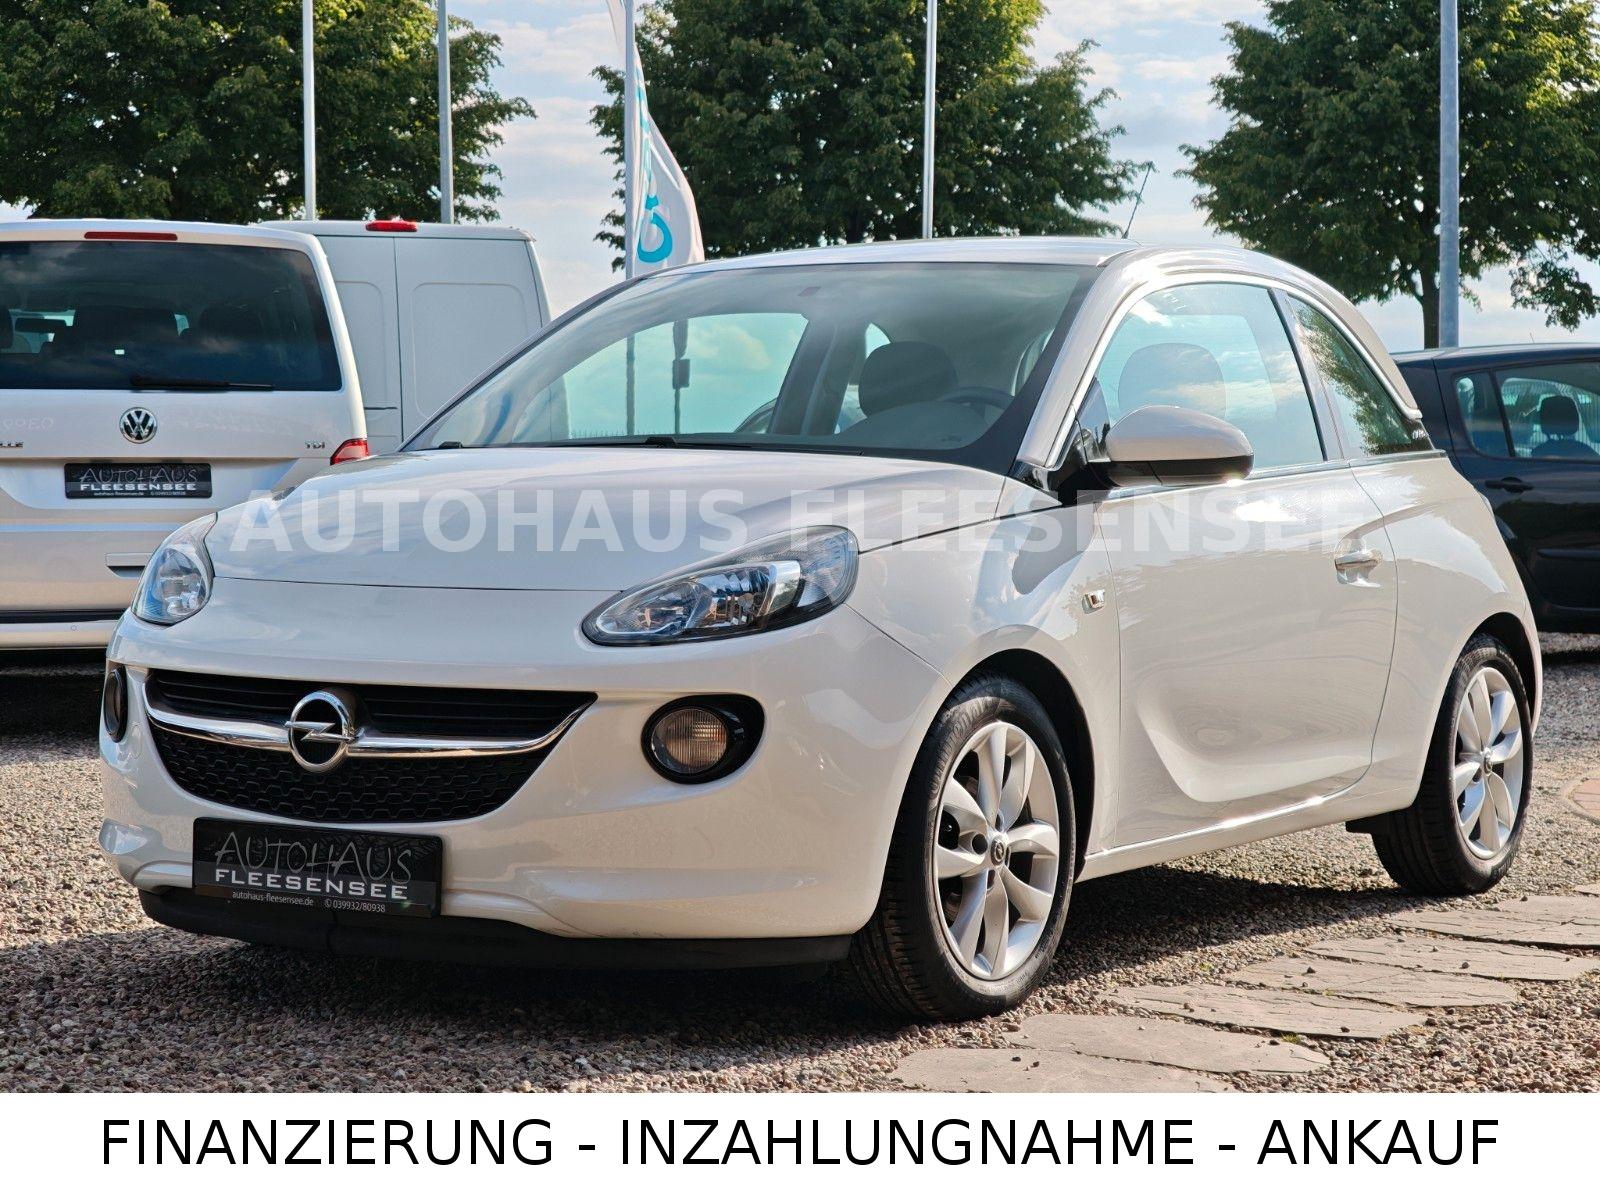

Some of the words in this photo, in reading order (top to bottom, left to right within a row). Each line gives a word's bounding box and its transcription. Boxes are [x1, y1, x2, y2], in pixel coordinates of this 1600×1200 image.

[79, 467, 198, 484] AUTOHAUS
[80, 483, 197, 491] FLEESENSEE
[214, 831, 412, 885] AUTOHAUS
[215, 868, 409, 900] FLEESENSEE
[232, 890, 314, 907] autohaus-fleesensee.de
